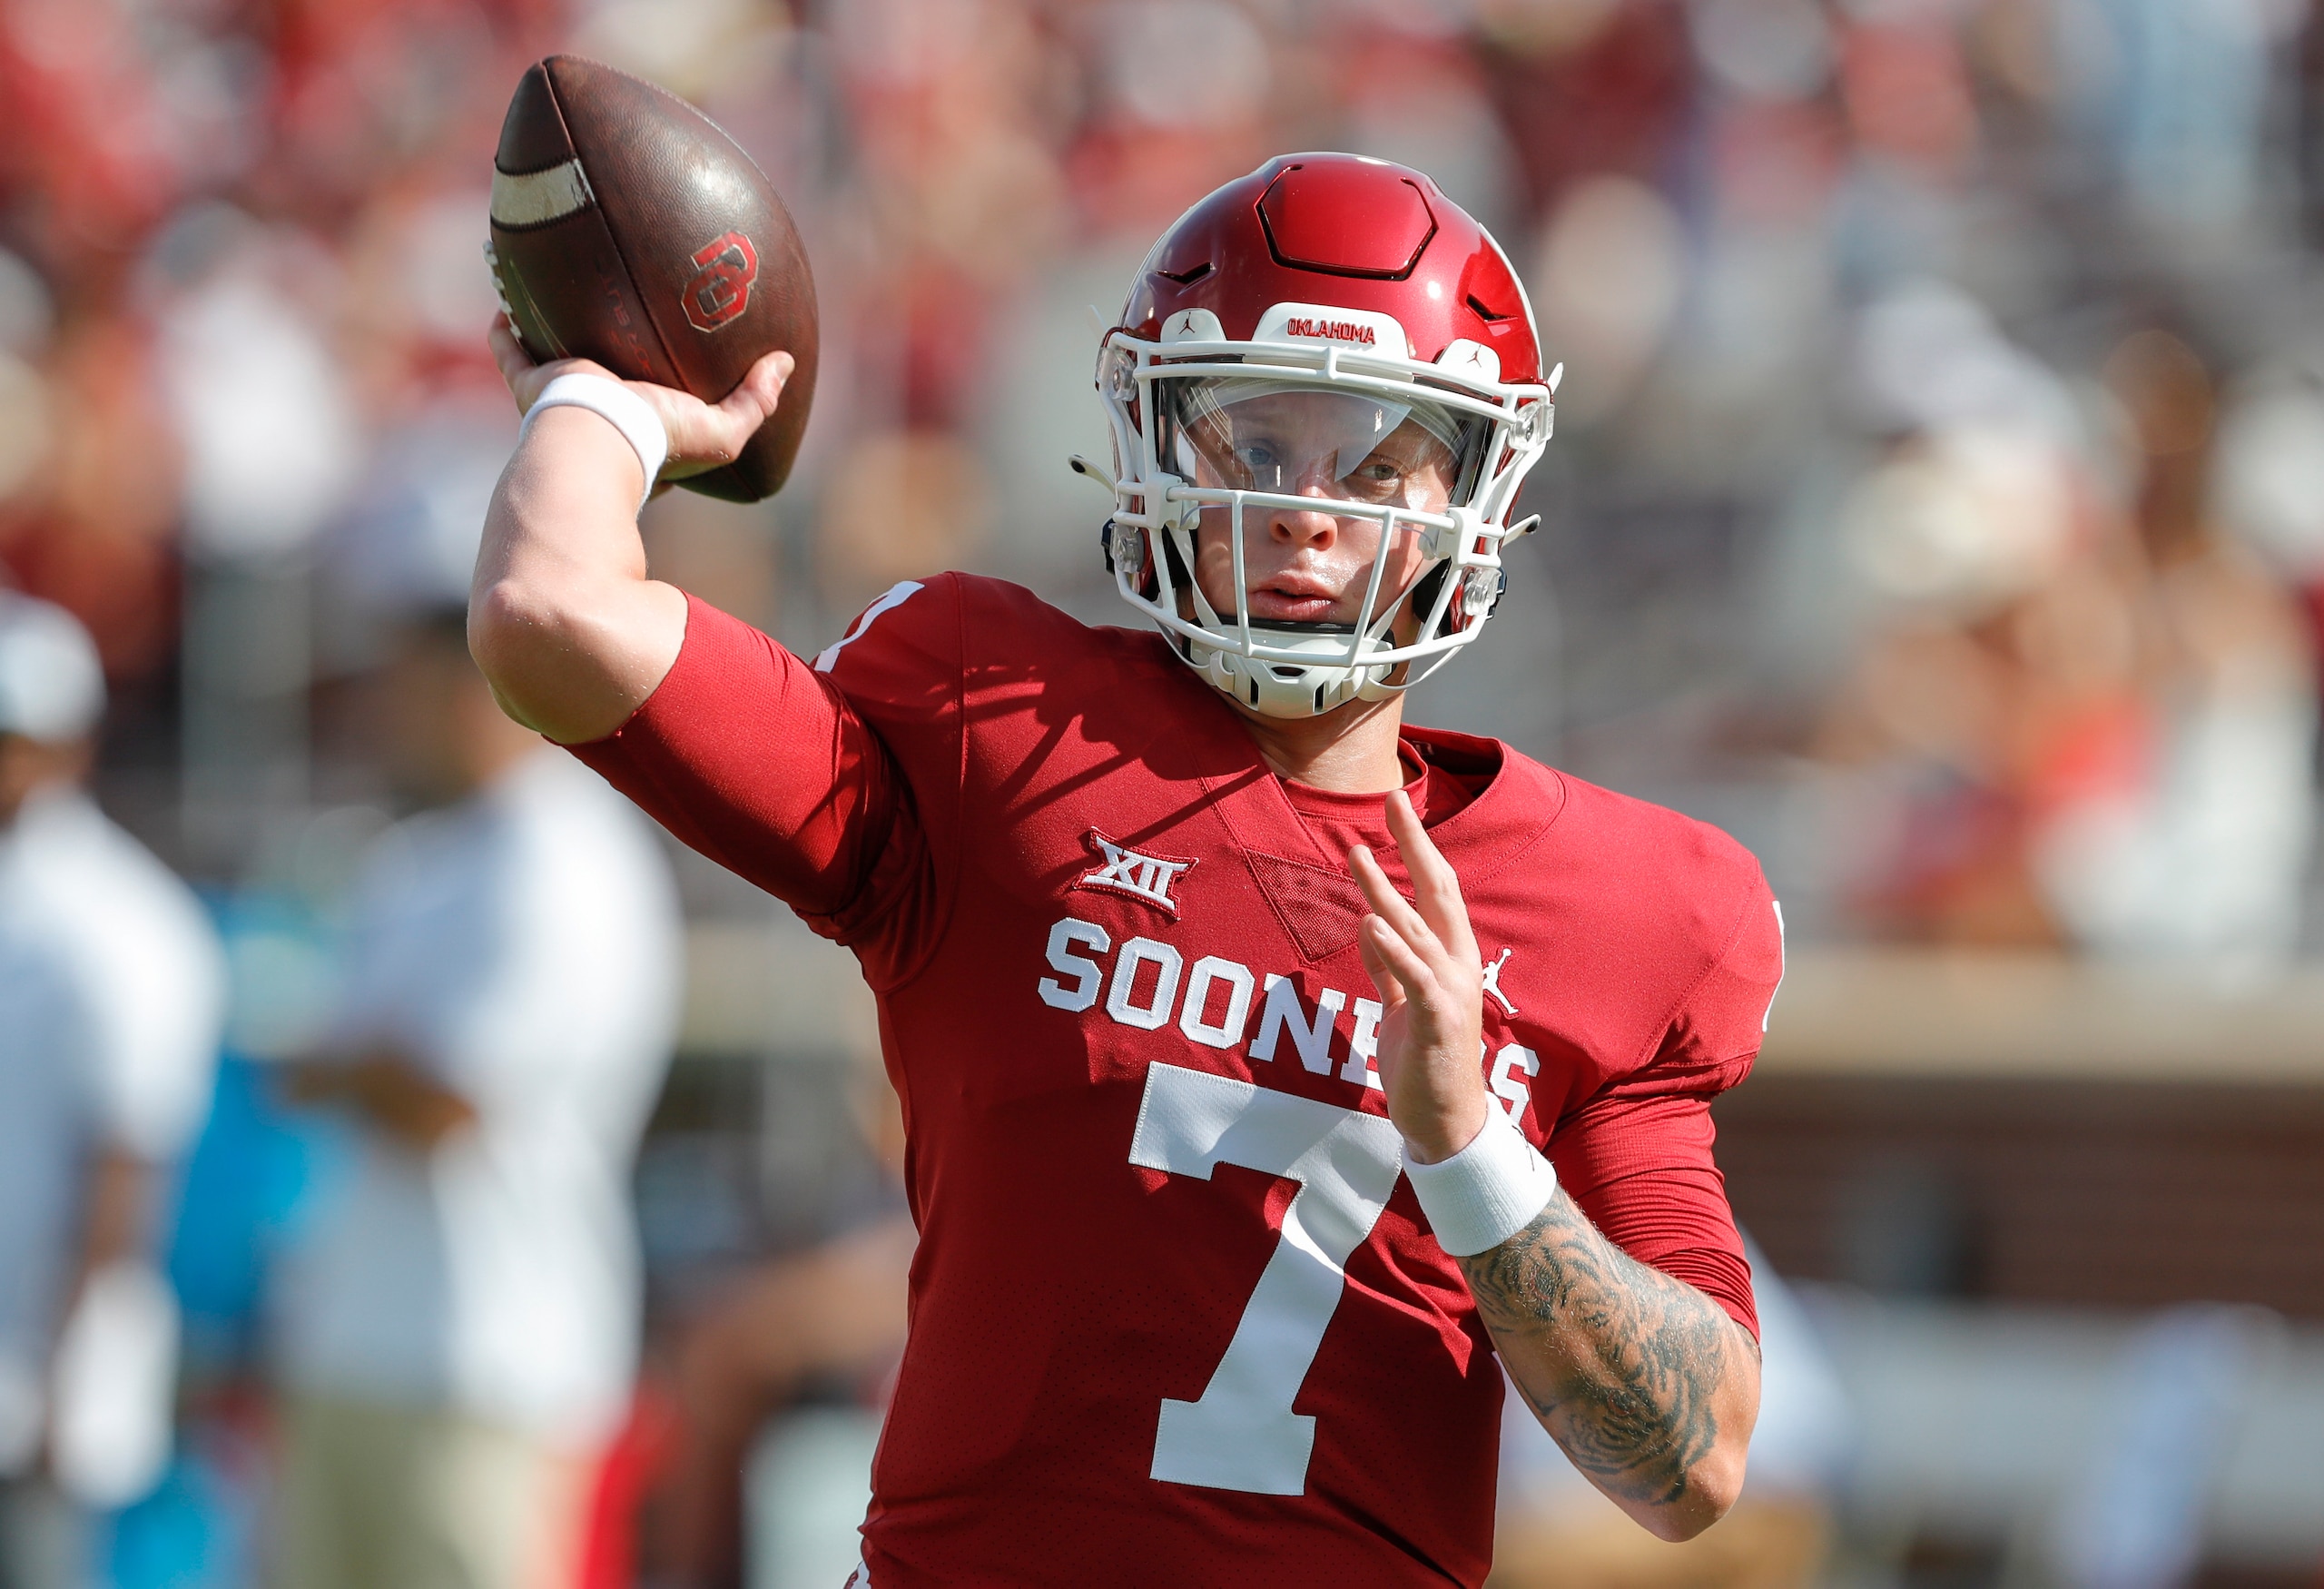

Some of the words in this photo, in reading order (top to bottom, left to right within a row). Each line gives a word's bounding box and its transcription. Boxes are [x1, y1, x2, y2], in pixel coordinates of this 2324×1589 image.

[1288, 318, 1376, 345] OKLAHOMA
[1081, 835, 1189, 911] XII
[1038, 917, 1541, 1126] SOONES
[1128, 1061, 1405, 1496] 7
